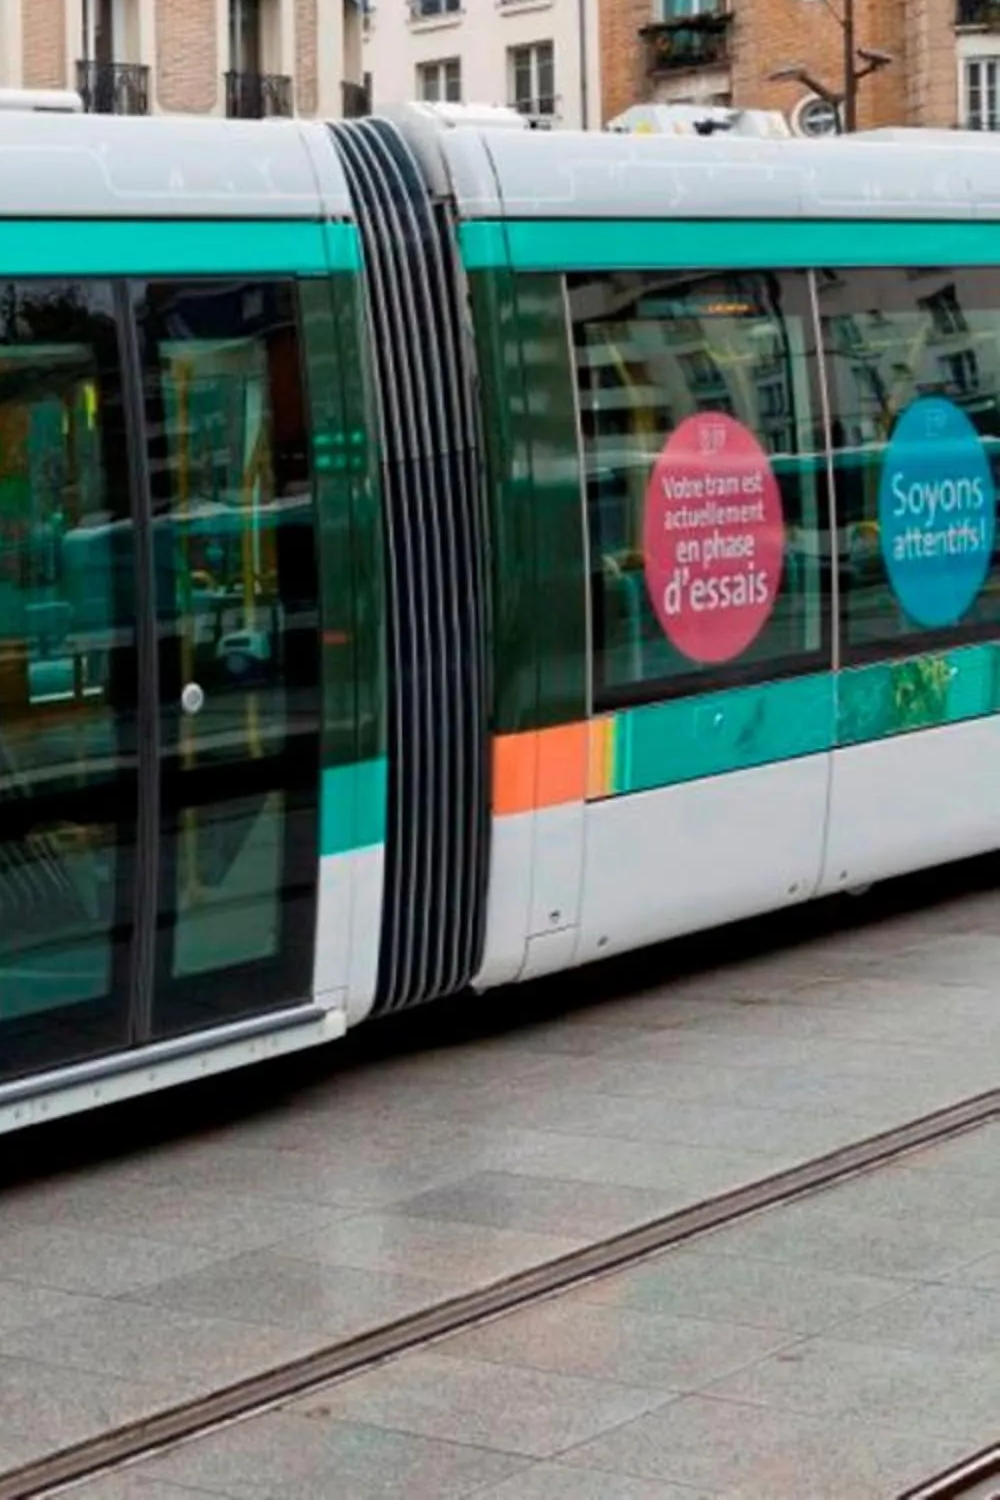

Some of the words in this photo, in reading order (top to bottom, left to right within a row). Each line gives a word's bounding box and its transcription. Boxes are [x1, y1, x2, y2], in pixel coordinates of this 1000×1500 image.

[661, 476, 703, 500] Votre
[705, 474, 739, 497] tram
[741, 470, 763, 495] est
[891, 471, 984, 528] Soyons
[664, 500, 764, 531] actuellement
[676, 540, 700, 563] en
[702, 528, 755, 571] phase
[664, 561, 768, 615] d'essais
